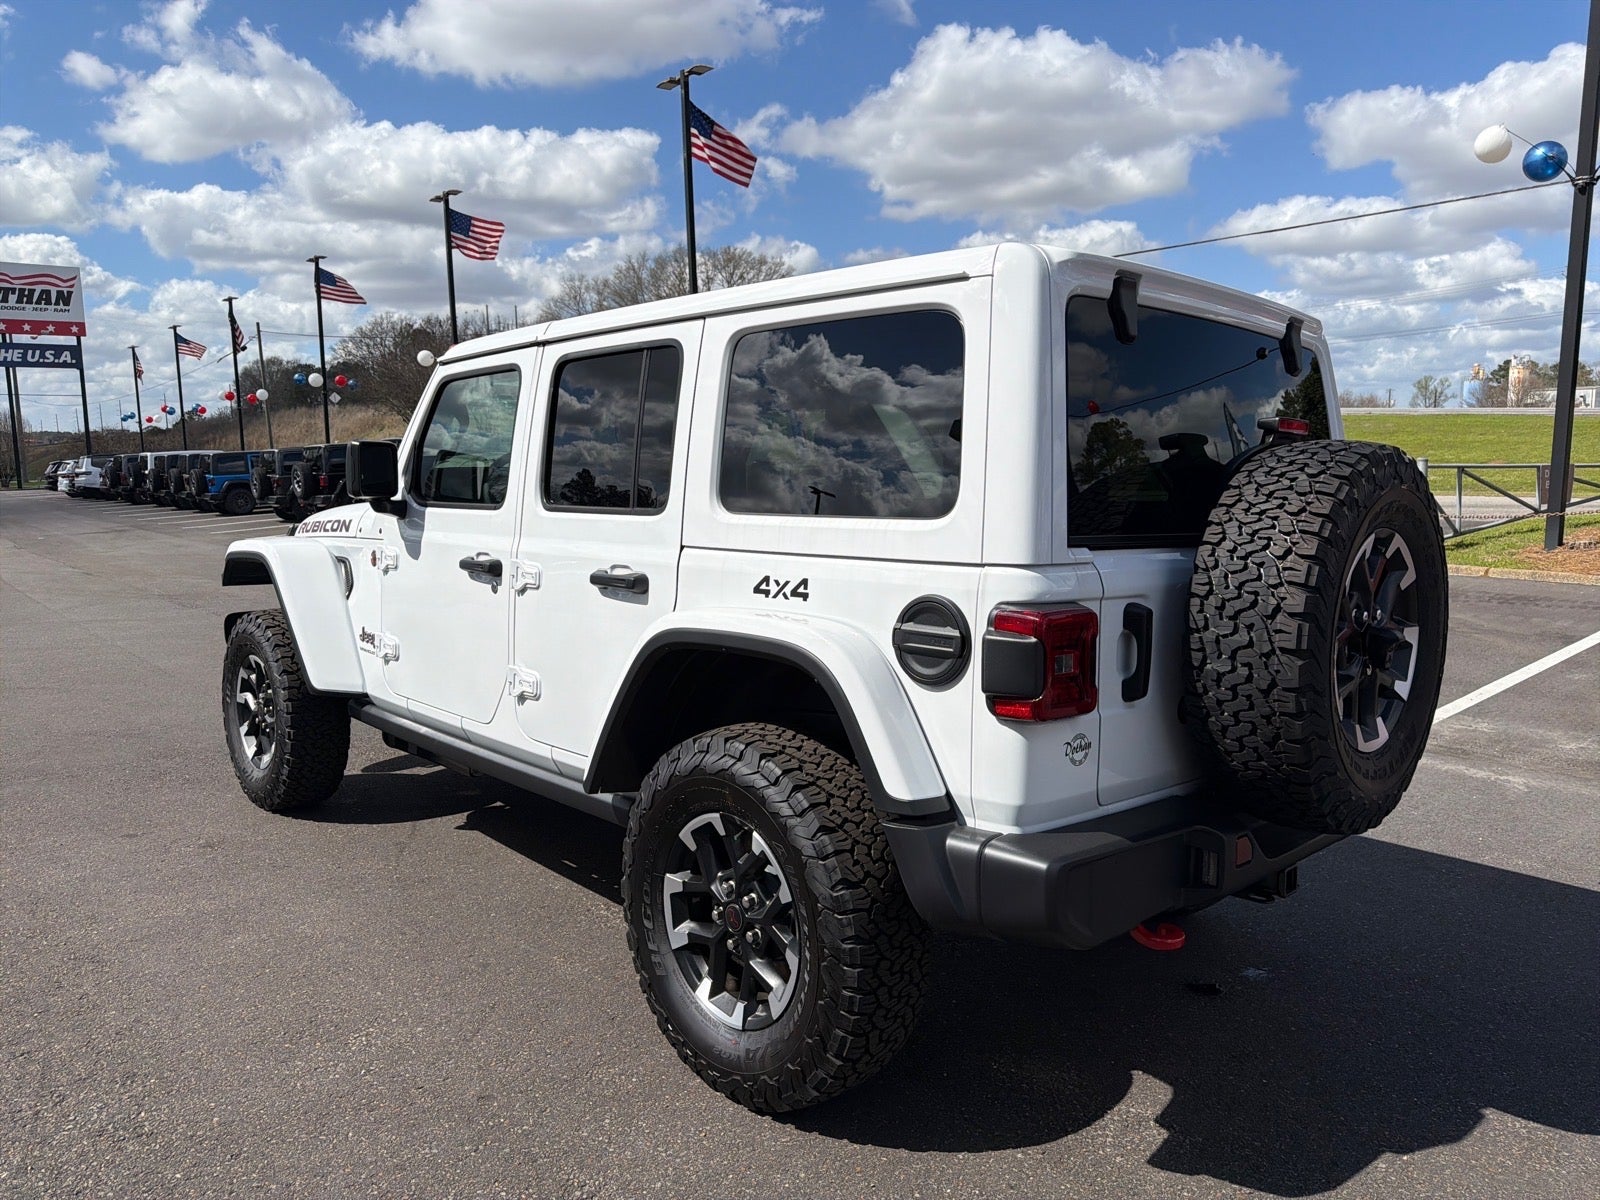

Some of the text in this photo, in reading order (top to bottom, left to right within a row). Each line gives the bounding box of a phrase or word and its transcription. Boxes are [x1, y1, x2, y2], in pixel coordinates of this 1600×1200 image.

[26, 349, 77, 364] U.S.A.
[298, 519, 353, 534] RUBICON
[359, 626, 375, 649] Jeep
[1063, 739, 1092, 757] Dothan
